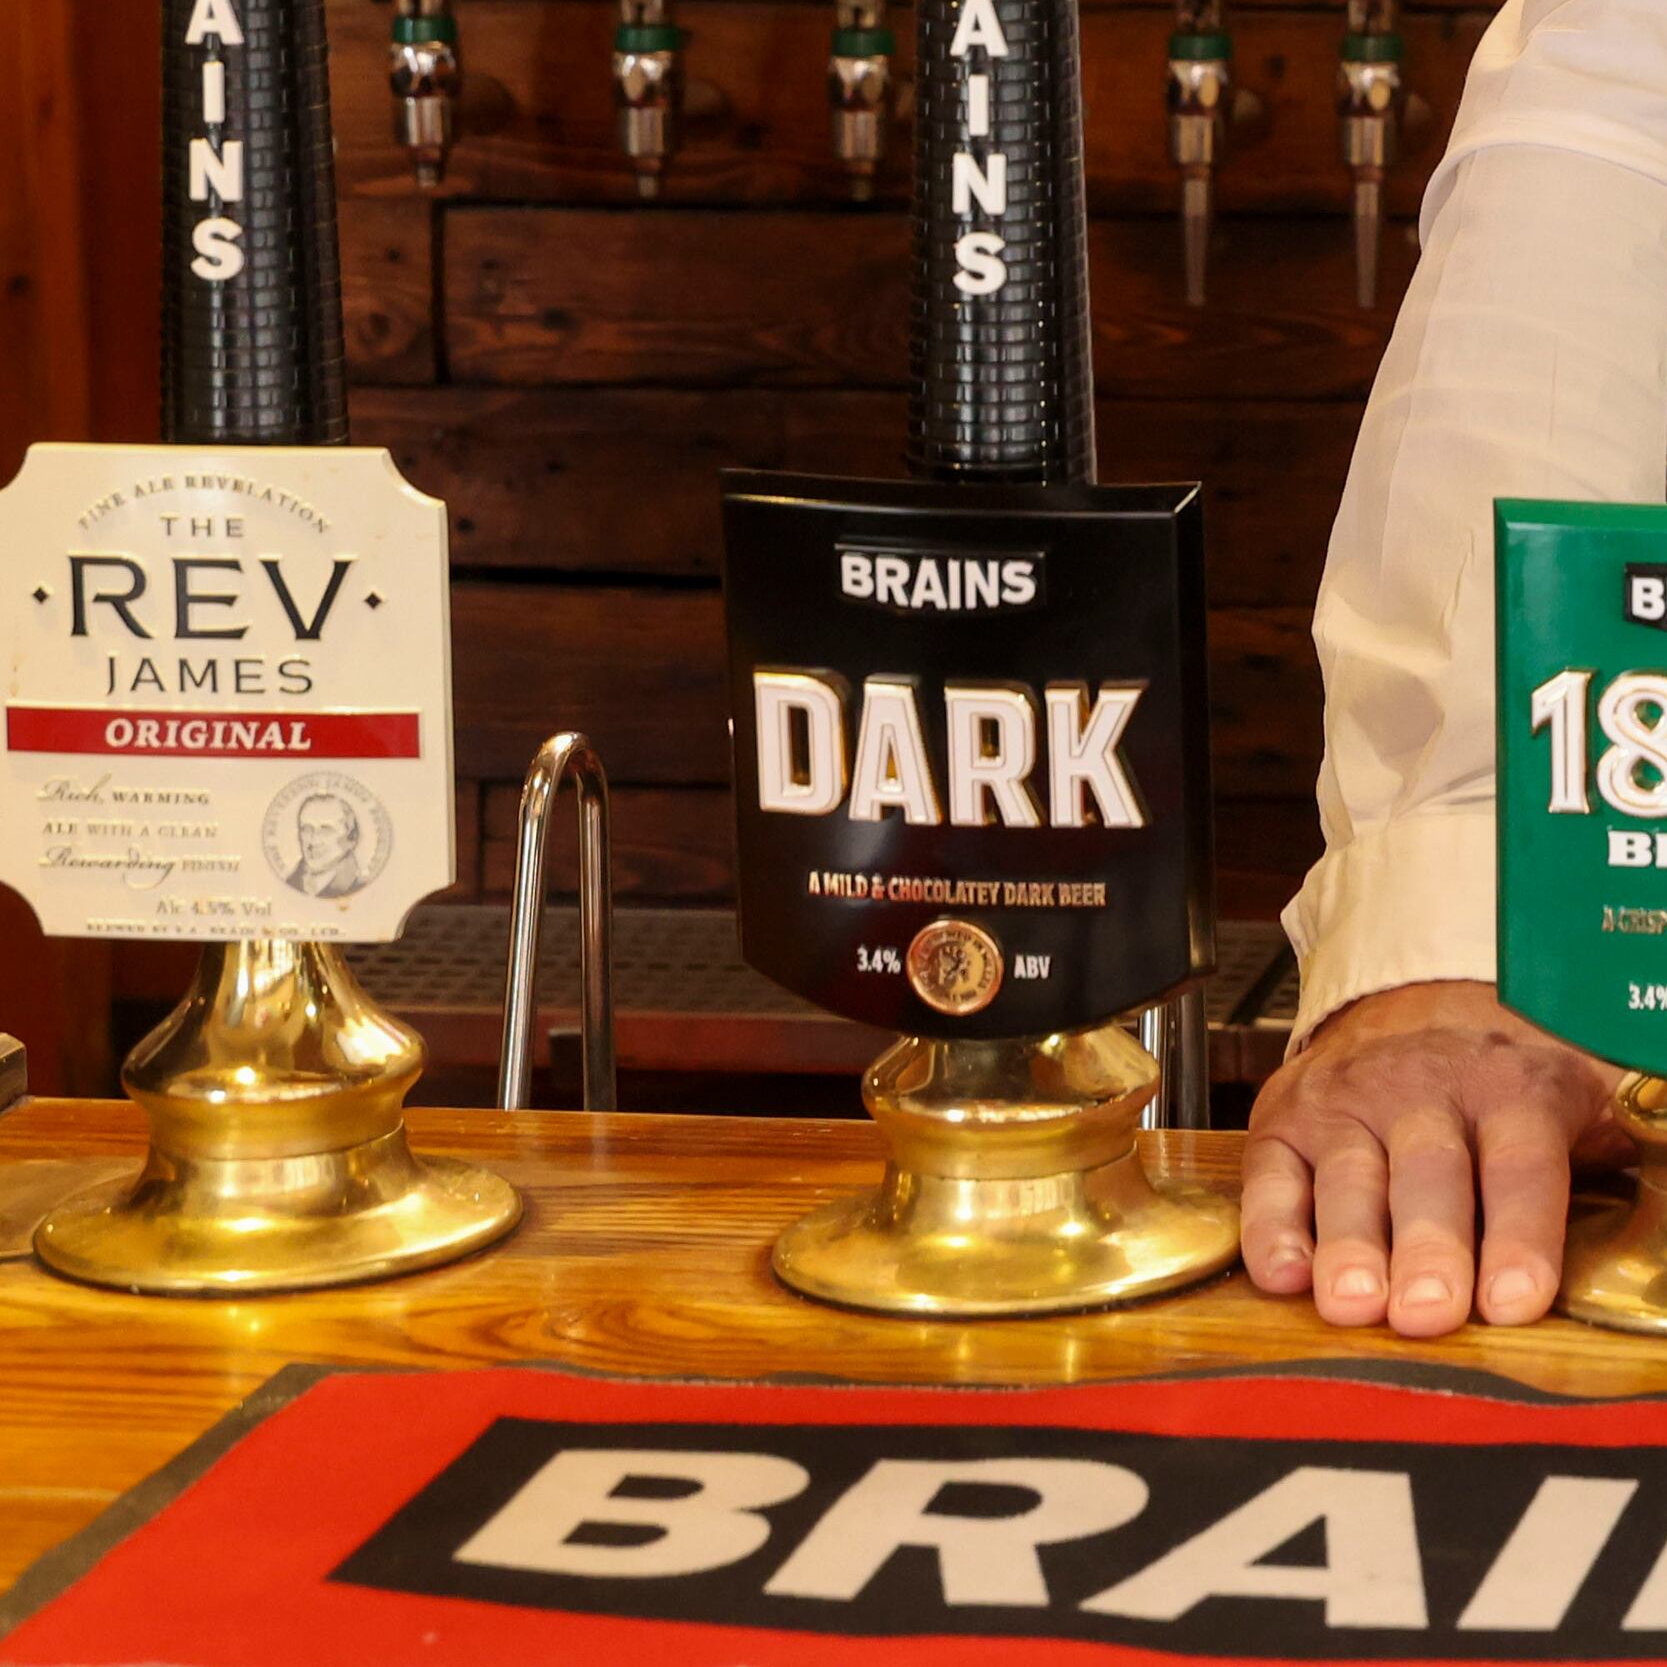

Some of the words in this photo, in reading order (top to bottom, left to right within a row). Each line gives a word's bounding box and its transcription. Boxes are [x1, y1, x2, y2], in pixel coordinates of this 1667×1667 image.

[79, 494, 126, 530] FINE
[134, 476, 175, 499] ALE
[184, 472, 330, 535] REVELATION
[160, 516, 246, 539] THE
[67, 554, 358, 642] REV
[841, 554, 1036, 610] BRAINS
[106, 655, 314, 697] JAMES
[104, 718, 313, 751] ORIGINAL
[754, 667, 1150, 829] DARK
[112, 790, 211, 807] WARMING
[42, 821, 79, 837] ALE
[87, 823, 132, 838] WITH
[139, 824, 150, 839] A
[40, 844, 177, 890] Rewarding
[807, 870, 821, 896] A
[823, 872, 869, 900] MILD
[870, 874, 887, 902] &
[887, 876, 1001, 906] CHOCOLATEY
[1003, 880, 1056, 906] DARK
[1057, 881, 1107, 907] BEER
[155, 899, 183, 916] Alc
[241, 901, 273, 917] Vol
[1602, 905, 1615, 933] A
[857, 945, 902, 974] 3.4%
[1014, 952, 1052, 980] ABV
